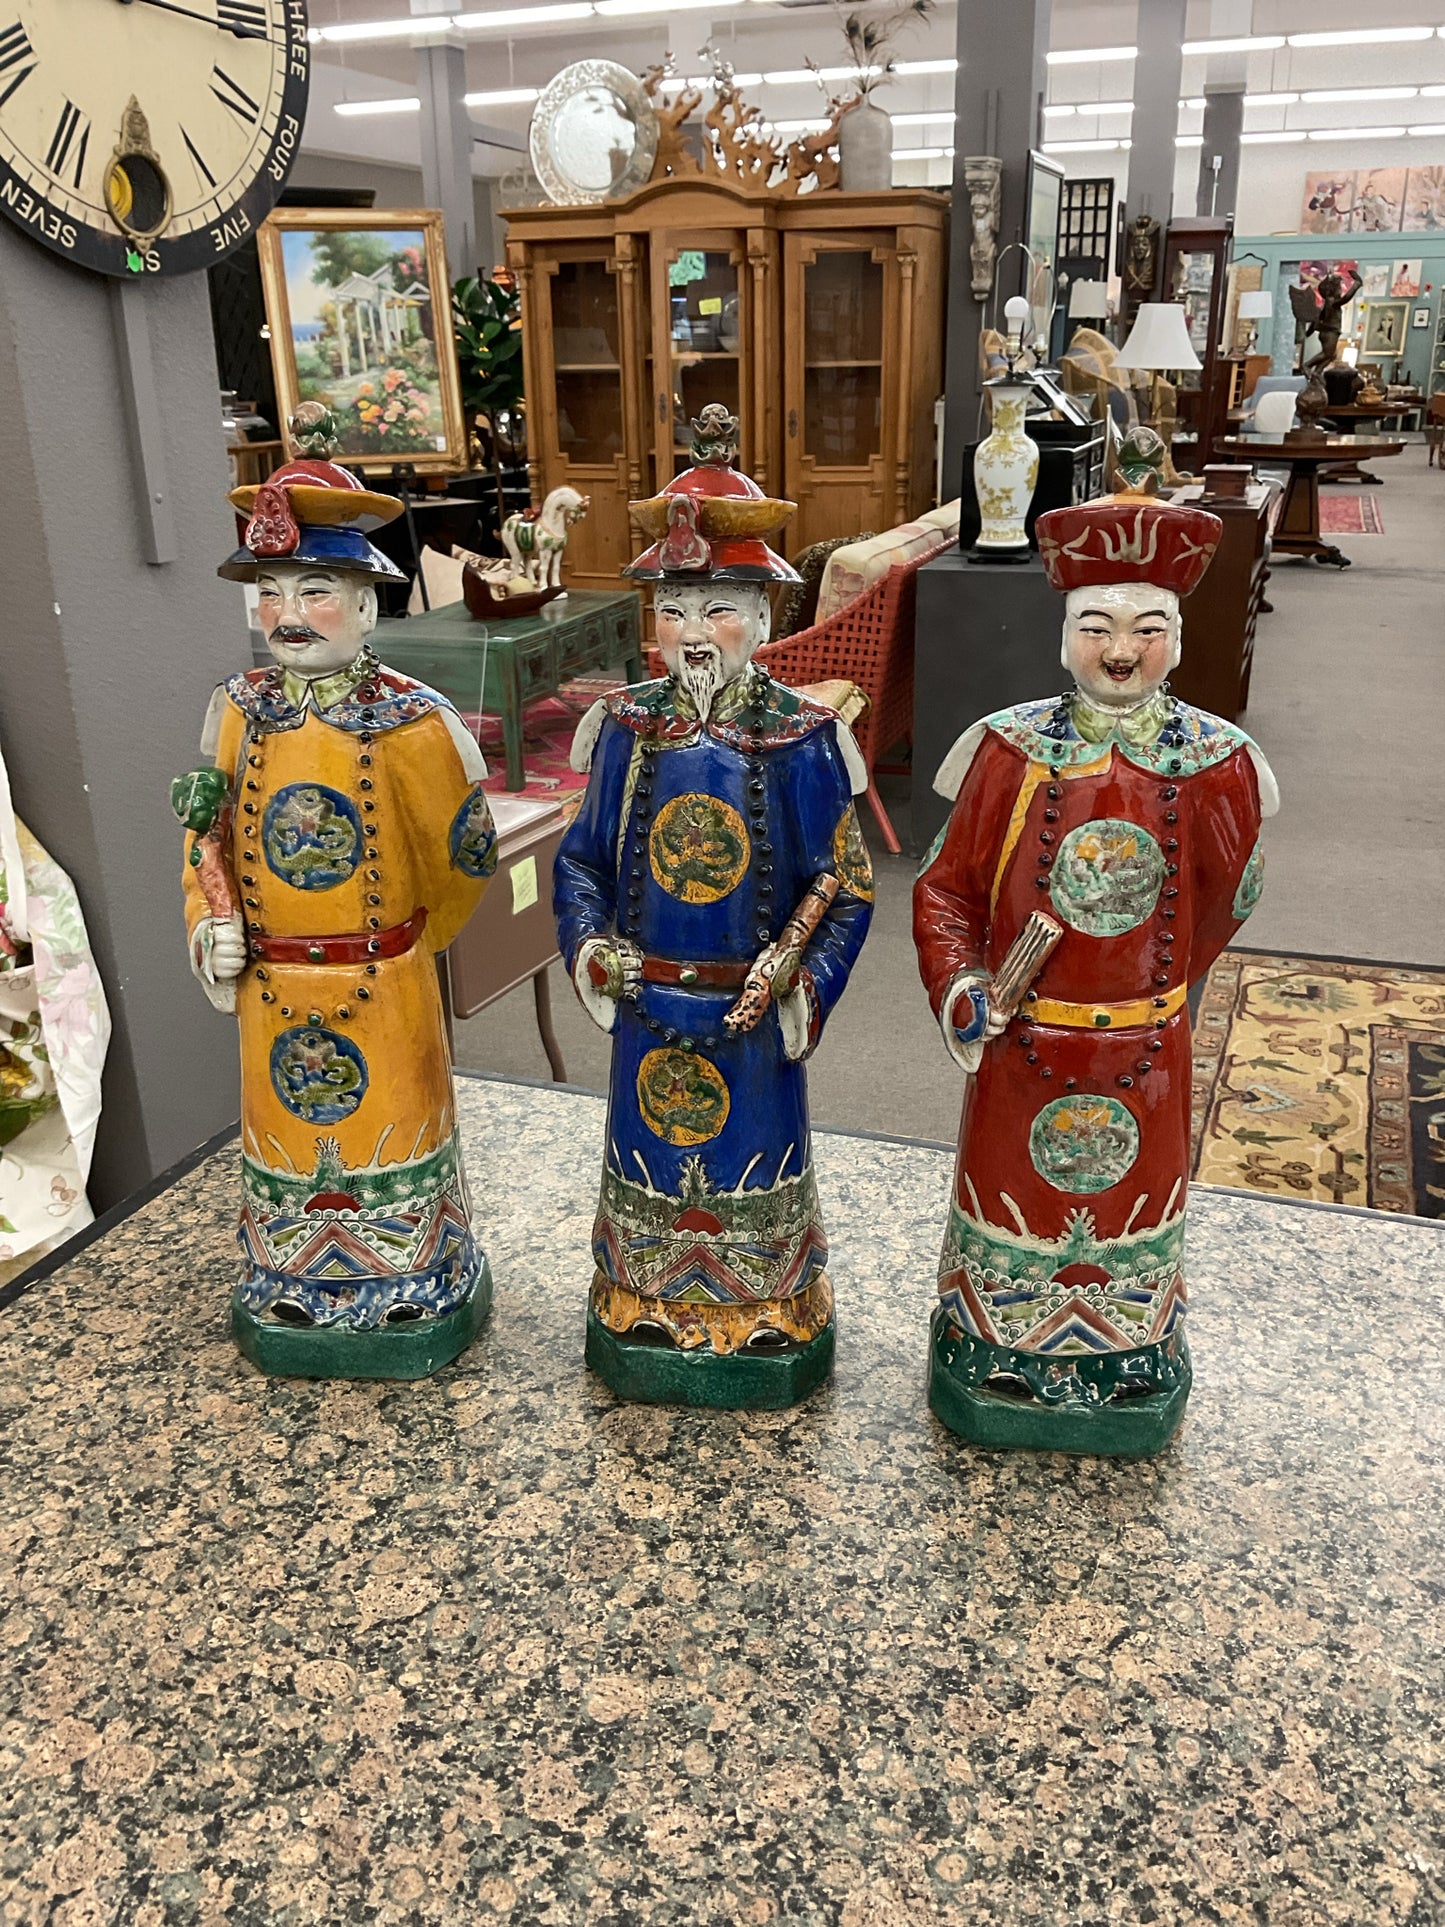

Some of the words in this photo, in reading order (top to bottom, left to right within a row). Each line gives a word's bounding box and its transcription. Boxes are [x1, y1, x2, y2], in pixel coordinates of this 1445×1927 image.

[288, 0, 307, 82] HREE
[267, 114, 299, 182] FOUR
[1, 179, 78, 248] SEVEN
[210, 208, 252, 252] FIVE
[125, 247, 161, 272] SI
